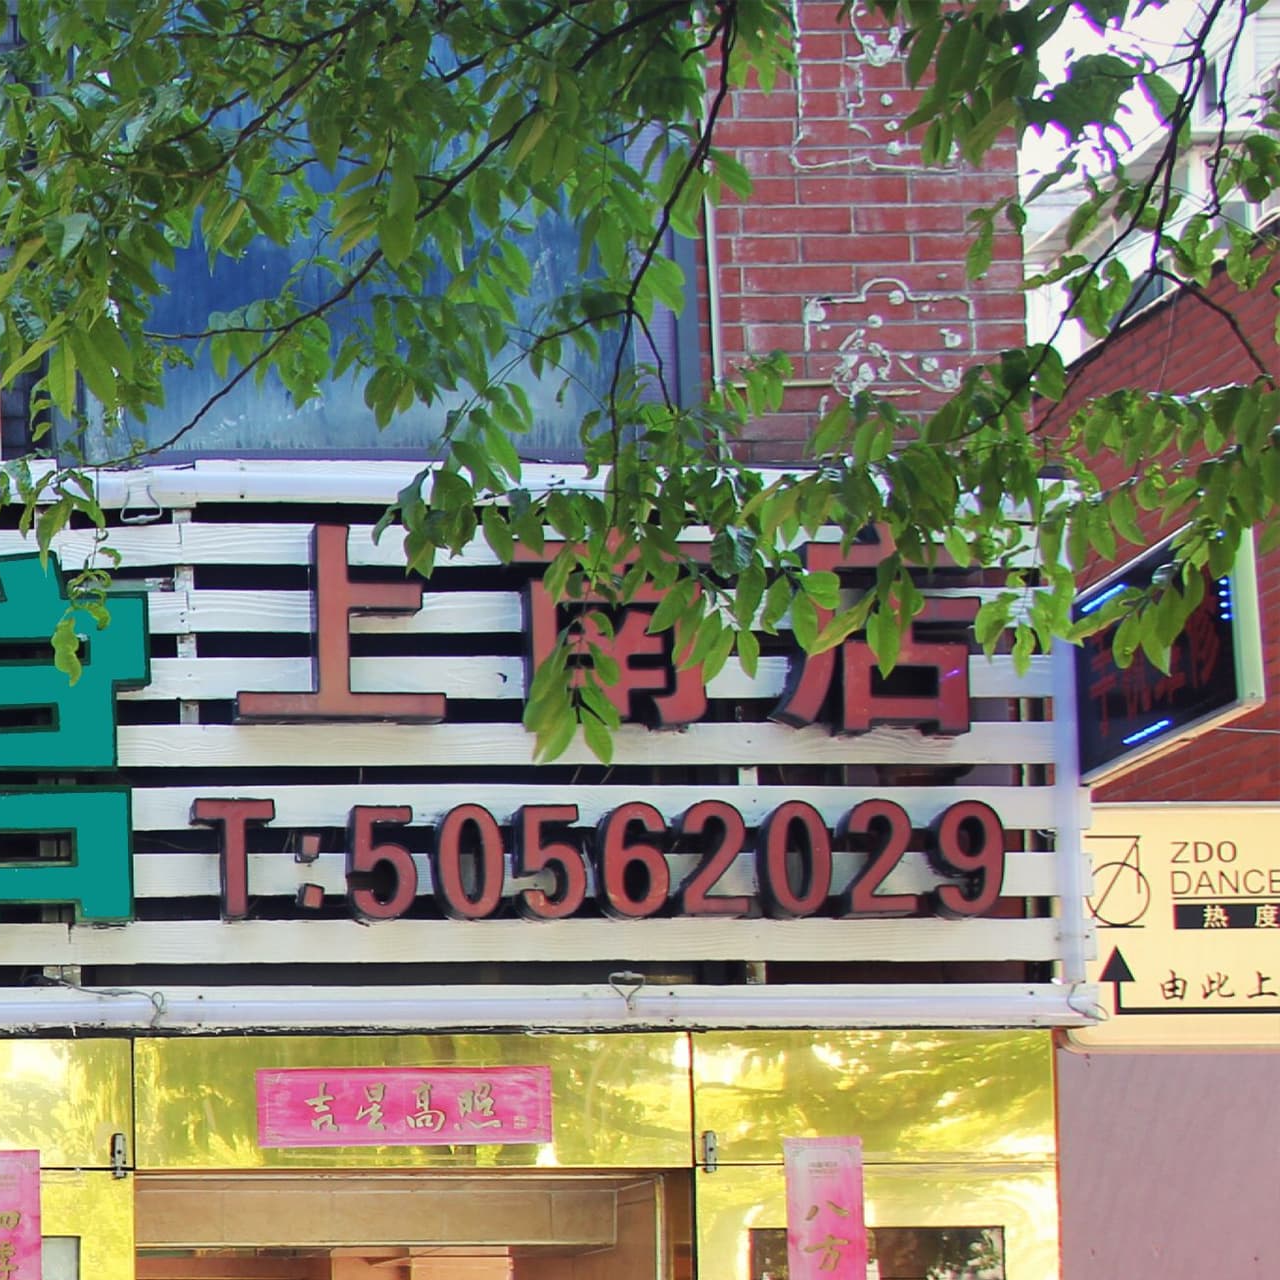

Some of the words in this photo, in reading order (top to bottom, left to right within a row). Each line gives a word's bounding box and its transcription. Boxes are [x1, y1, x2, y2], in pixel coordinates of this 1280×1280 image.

[190, 797, 1007, 923] T:50562029
[1170, 840, 1237, 864] ZDO
[1160, 969, 1279, 1000] 由此上
[304, 1081, 502, 1133] 吉星高照
